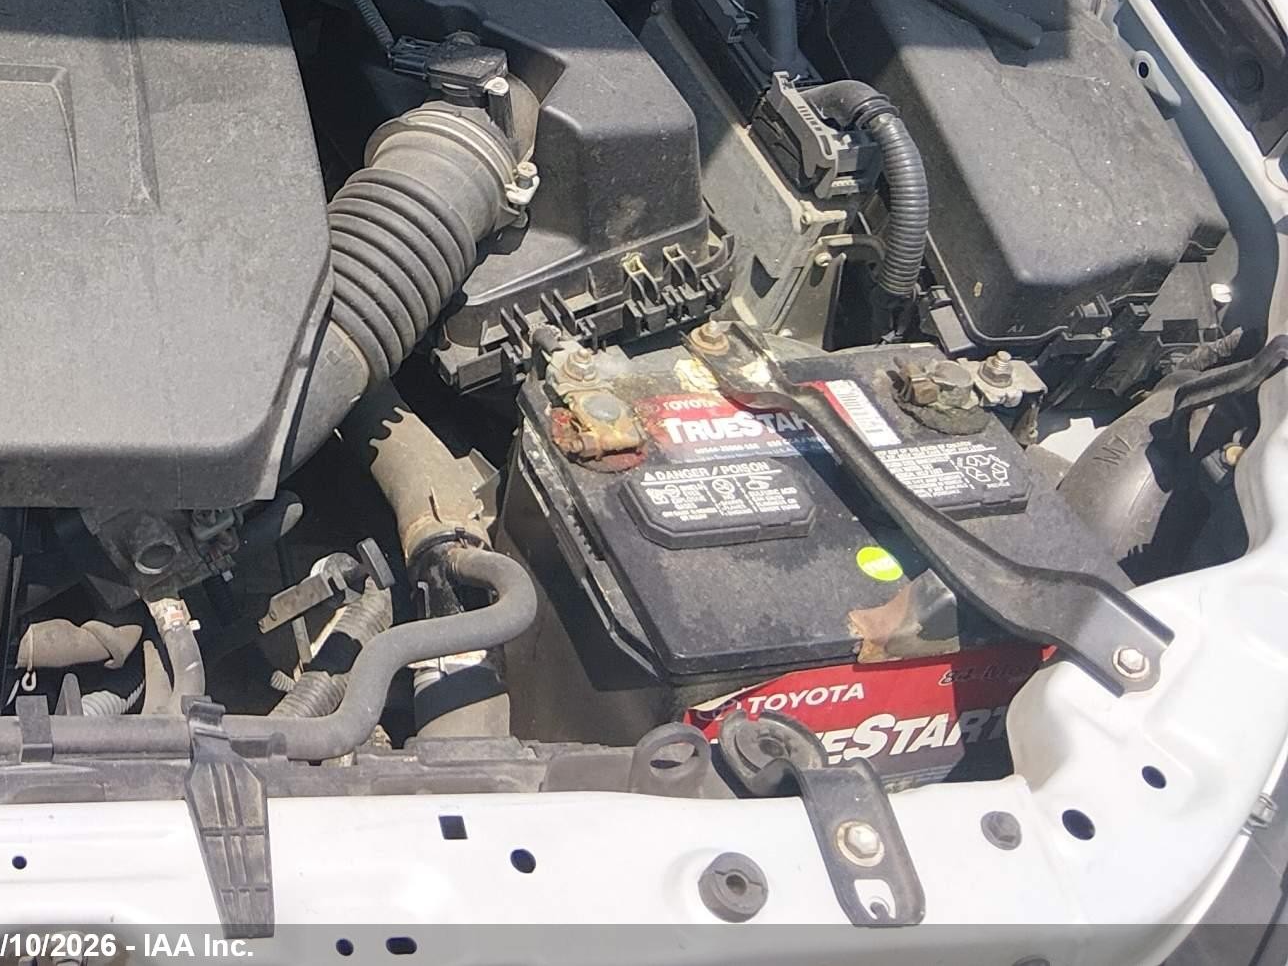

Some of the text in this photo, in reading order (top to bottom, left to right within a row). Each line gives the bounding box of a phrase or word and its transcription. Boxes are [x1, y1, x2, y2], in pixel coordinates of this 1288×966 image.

[664, 410, 806, 444] TRUESTA
[655, 467, 710, 481] DANGER
[721, 461, 770, 475] POISON
[747, 682, 864, 714] TOYOTA
[815, 706, 1011, 764] ESTART
